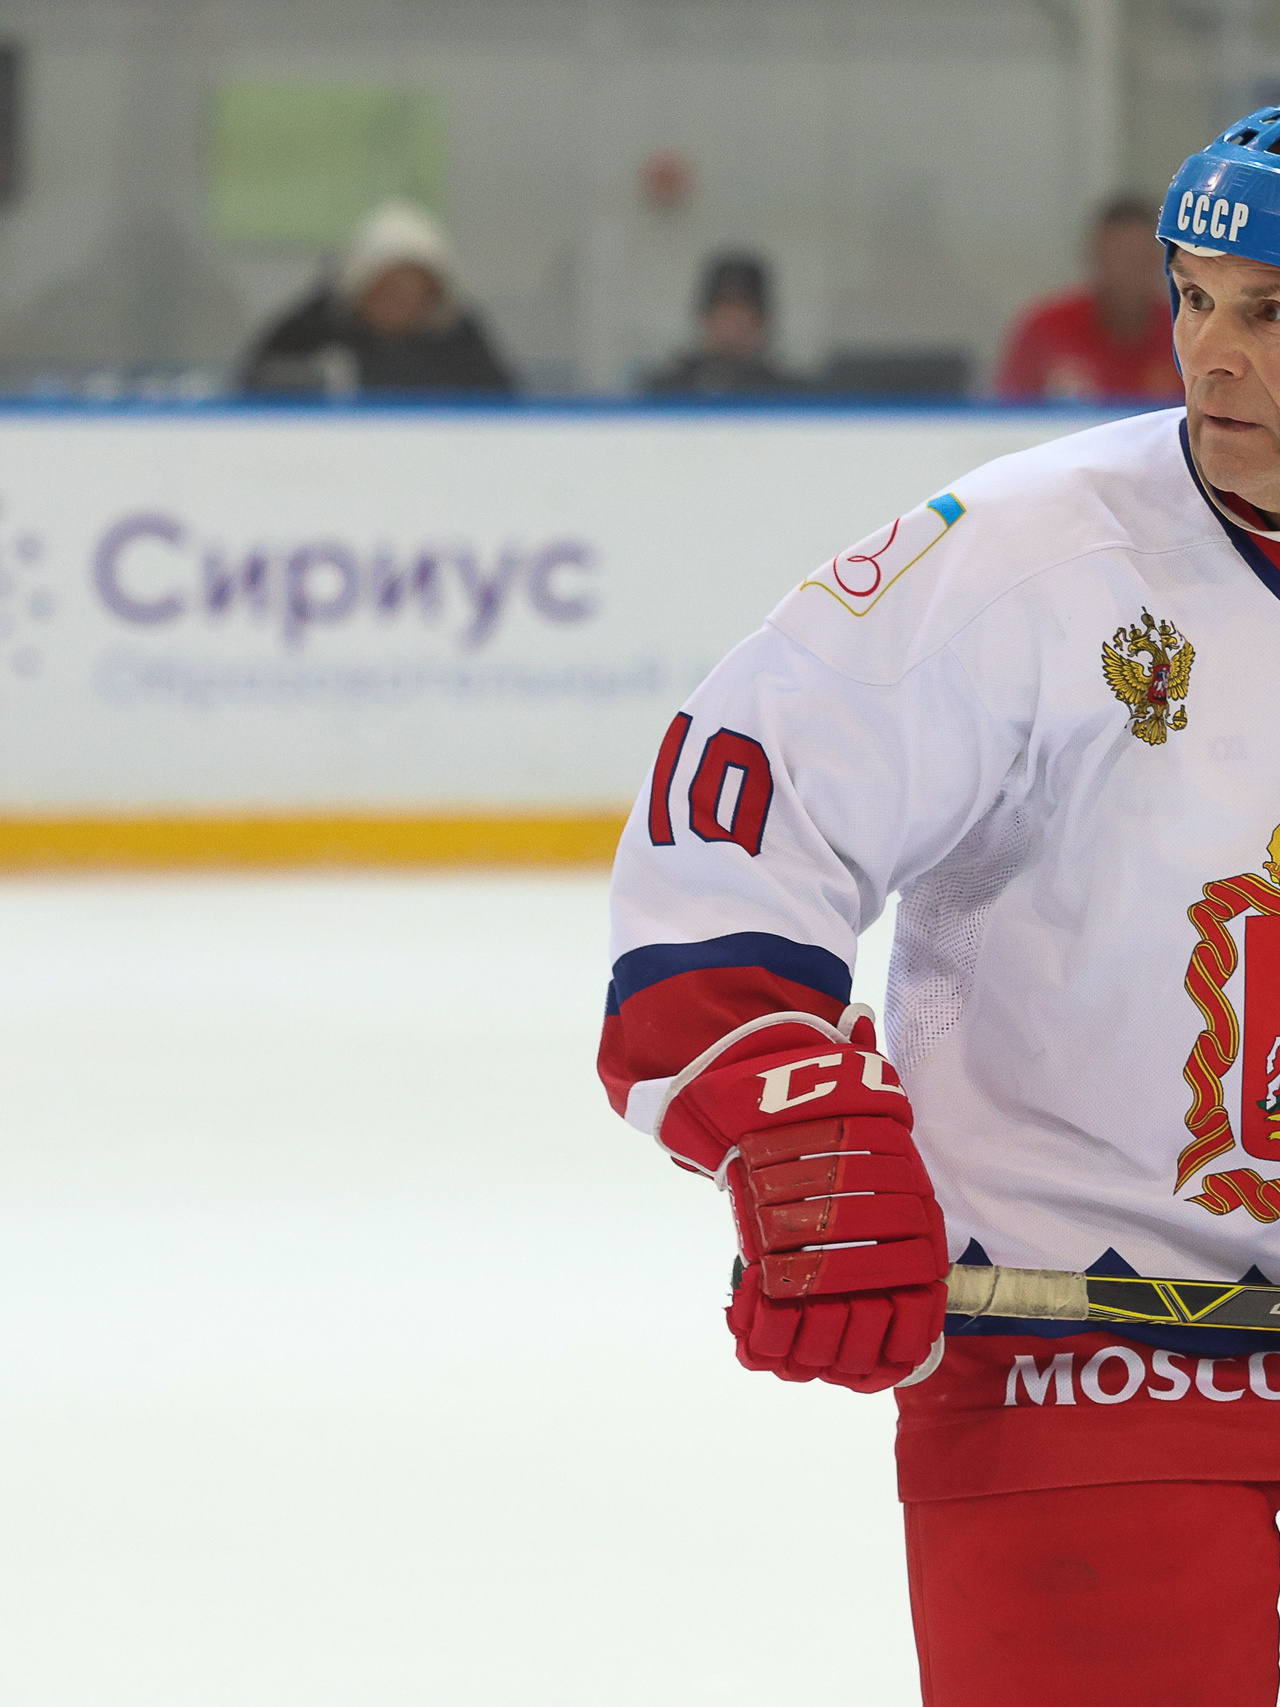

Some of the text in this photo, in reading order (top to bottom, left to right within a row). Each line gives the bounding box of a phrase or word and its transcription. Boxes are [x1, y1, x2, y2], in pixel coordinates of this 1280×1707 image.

[1177, 191, 1249, 242] СССР
[90, 512, 598, 646] Сириус
[648, 711, 774, 857] 10
